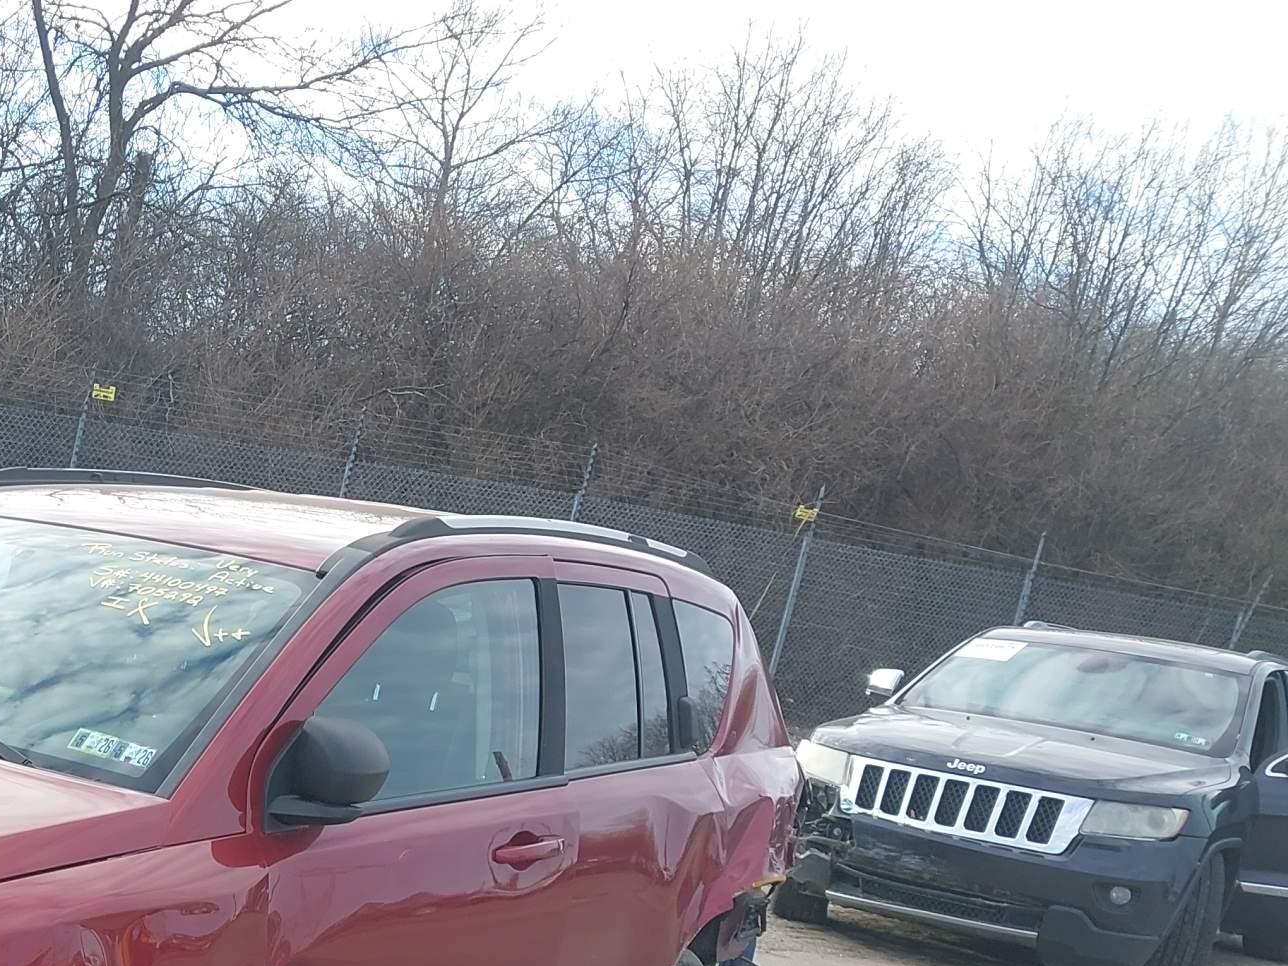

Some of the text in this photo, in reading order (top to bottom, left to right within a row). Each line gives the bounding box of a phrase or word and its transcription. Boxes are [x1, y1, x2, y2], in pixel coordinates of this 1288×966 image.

[215, 559, 259, 577] Very
[139, 571, 228, 597] 44100497
[208, 570, 274, 594] Active
[98, 737, 115, 754] 26
[136, 749, 154, 766] 26
[946, 758, 987, 775] Jeep
